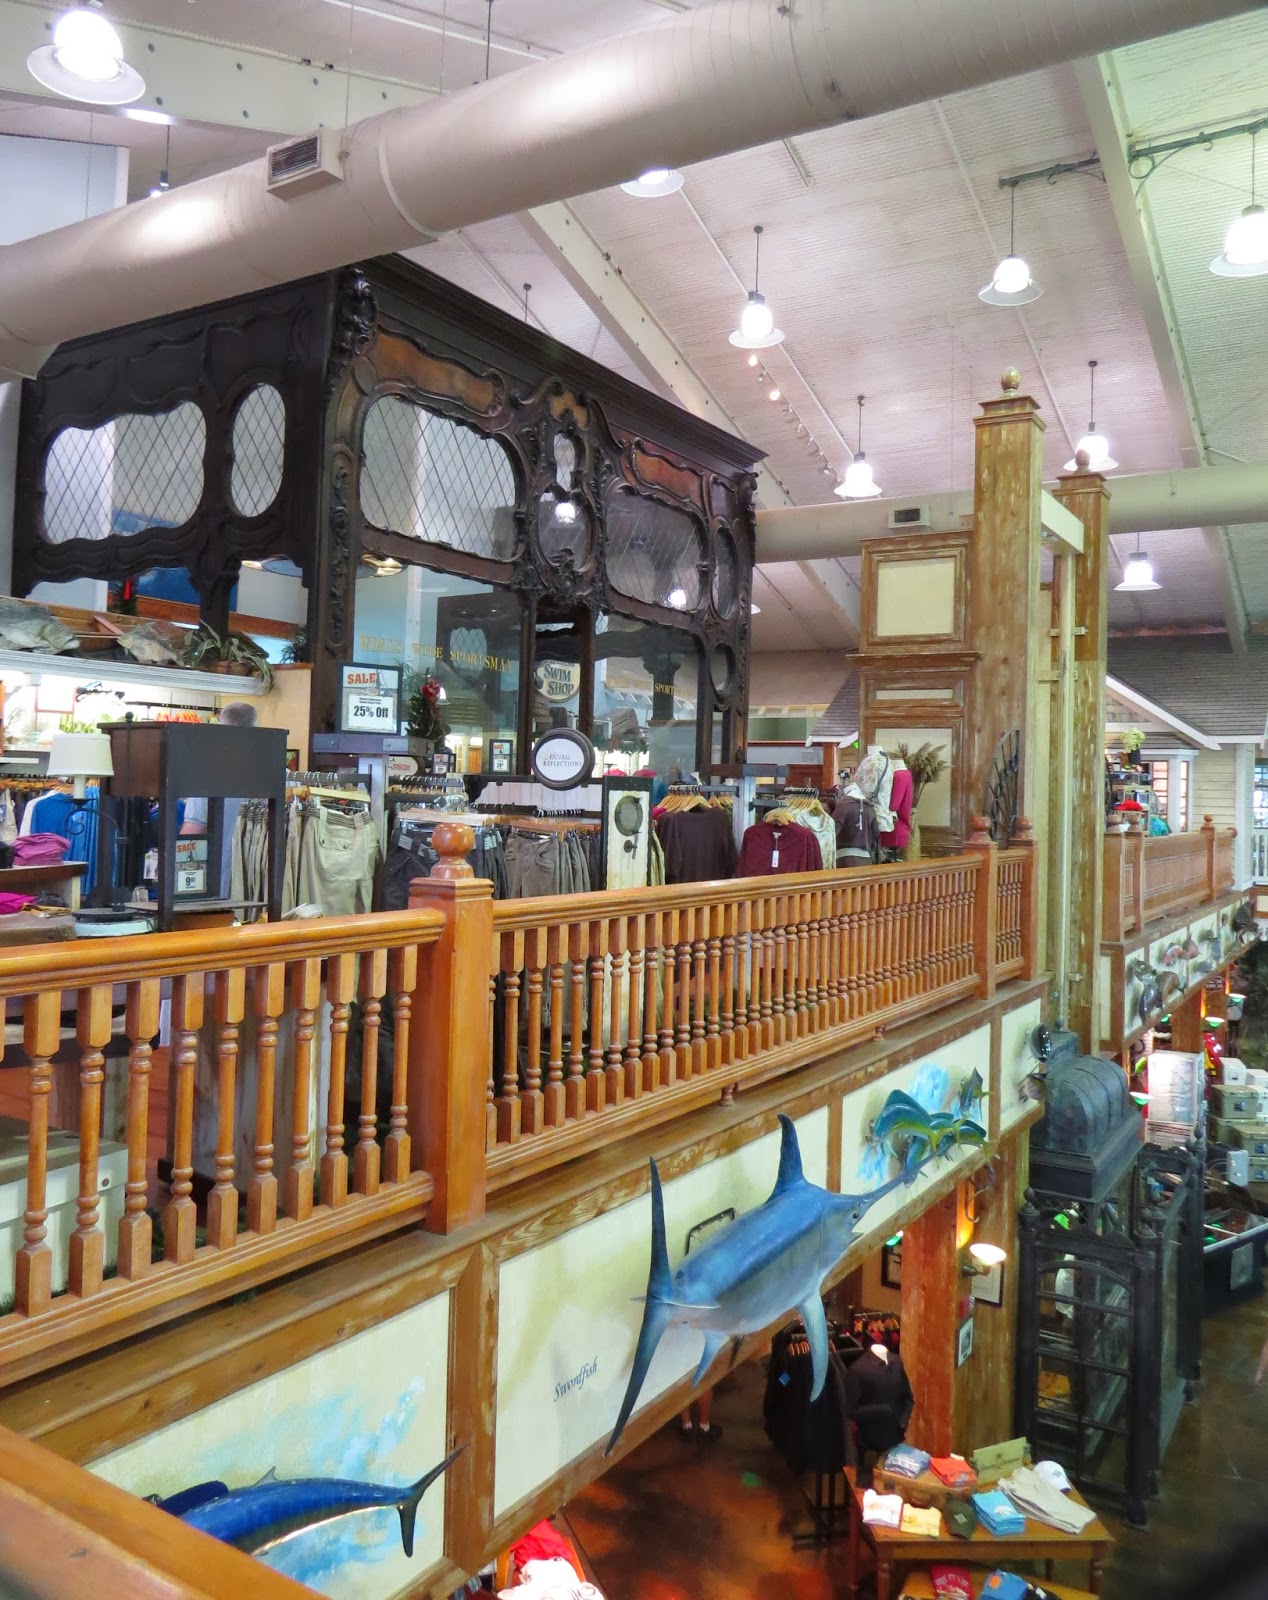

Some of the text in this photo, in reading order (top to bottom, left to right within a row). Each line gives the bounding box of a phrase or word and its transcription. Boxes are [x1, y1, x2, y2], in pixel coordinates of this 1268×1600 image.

[450, 650, 512, 673] SPORTSMAN
[347, 672, 376, 685] SALE
[544, 663, 571, 681] SWIM
[547, 680, 574, 695] SHOP
[354, 705, 389, 718] 25% Off
[176, 842, 196, 852] SALE
[553, 1355, 598, 1402] Swordfish
